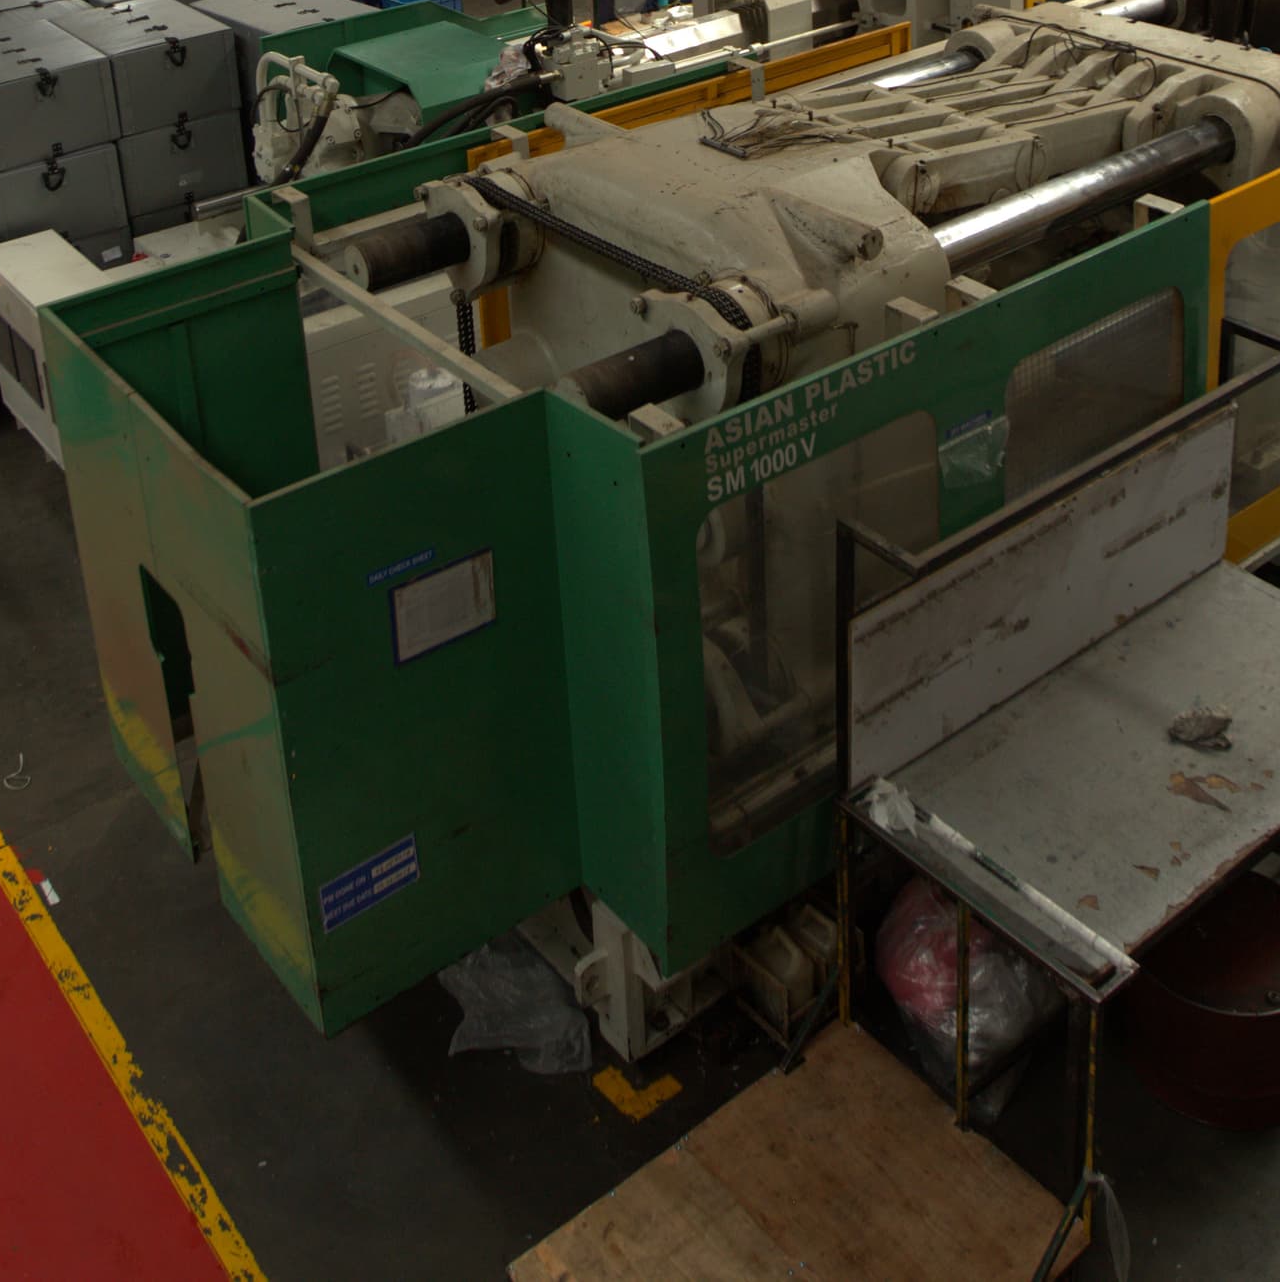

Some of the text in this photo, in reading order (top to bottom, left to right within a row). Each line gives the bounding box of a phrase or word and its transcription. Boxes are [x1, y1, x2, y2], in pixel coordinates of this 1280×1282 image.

[704, 341, 917, 454] ASIAN PLASTIC
[705, 401, 838, 474] Supermaster
[706, 432, 817, 503] SM 1000 V
